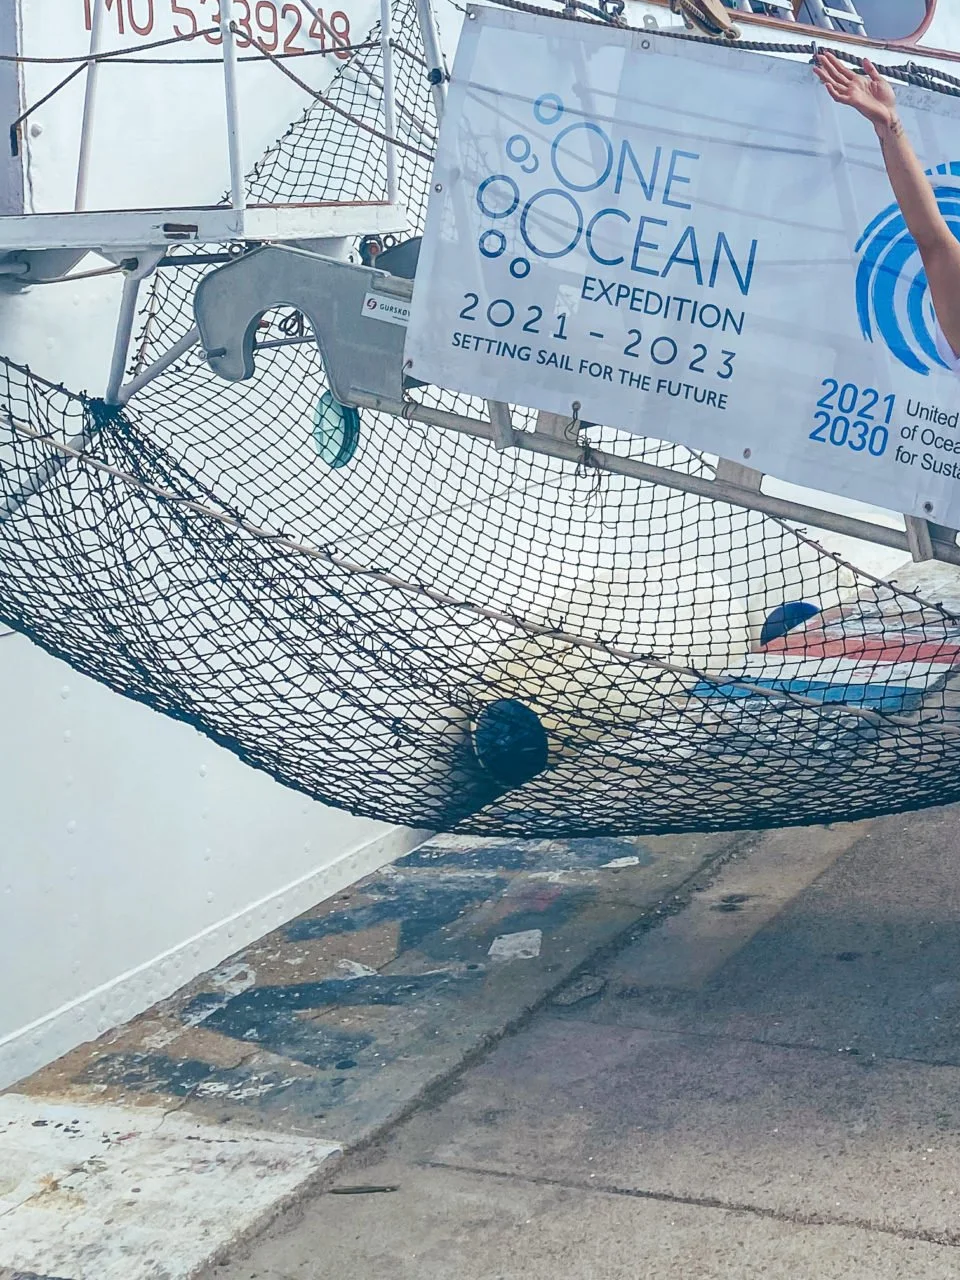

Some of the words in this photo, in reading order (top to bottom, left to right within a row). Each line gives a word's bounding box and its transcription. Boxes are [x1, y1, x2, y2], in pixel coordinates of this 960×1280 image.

[551, 122, 700, 210] ONE
[520, 188, 758, 296] OCEAN
[581, 276, 745, 335] EXPEDITION
[459, 293, 567, 340] 2021
[623, 329, 736, 379] 2023
[452, 332, 532, 361] SETTING
[536, 349, 573, 371] SAIL
[578, 359, 613, 381] FOR
[618, 369, 651, 391] THE
[656, 379, 728, 410] FUTURE
[816, 378, 896, 424] 2021
[906, 399, 960, 428] United
[808, 411, 889, 456] 2030
[895, 446, 918, 465] for
[901, 425, 919, 441] of
